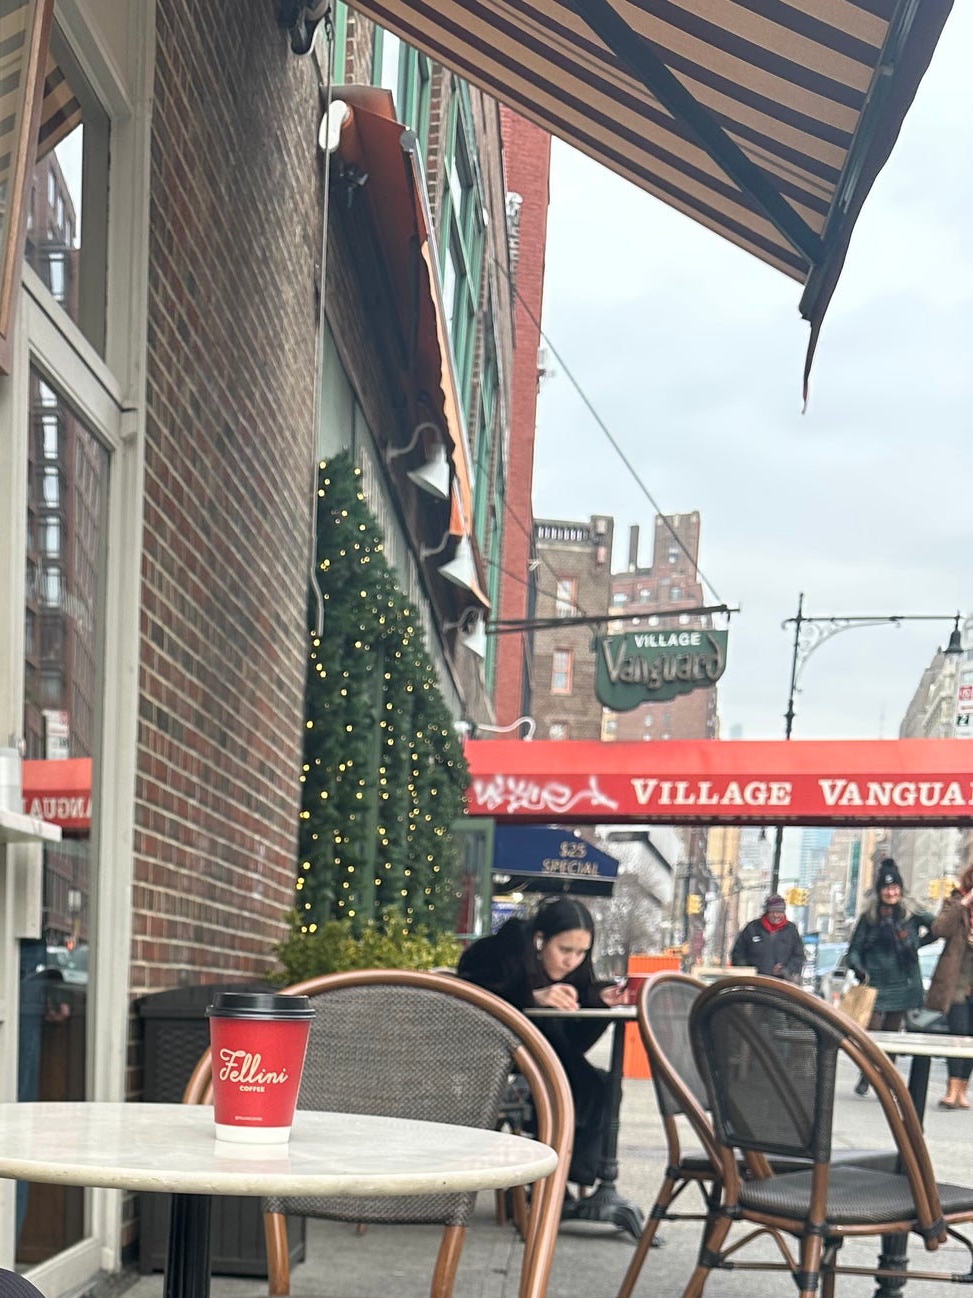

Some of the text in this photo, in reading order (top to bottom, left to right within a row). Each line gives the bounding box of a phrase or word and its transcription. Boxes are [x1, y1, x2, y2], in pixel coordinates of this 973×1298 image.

[634, 632, 702, 648] VILLAGE
[602, 632, 725, 690] Vanguard
[630, 778, 793, 806] VILLAGE
[818, 778, 973, 807] VANGUA
[542, 858, 600, 876] SPECIAL
[219, 1048, 290, 1085] Fellini
[239, 1085, 266, 1093] COFFEE
